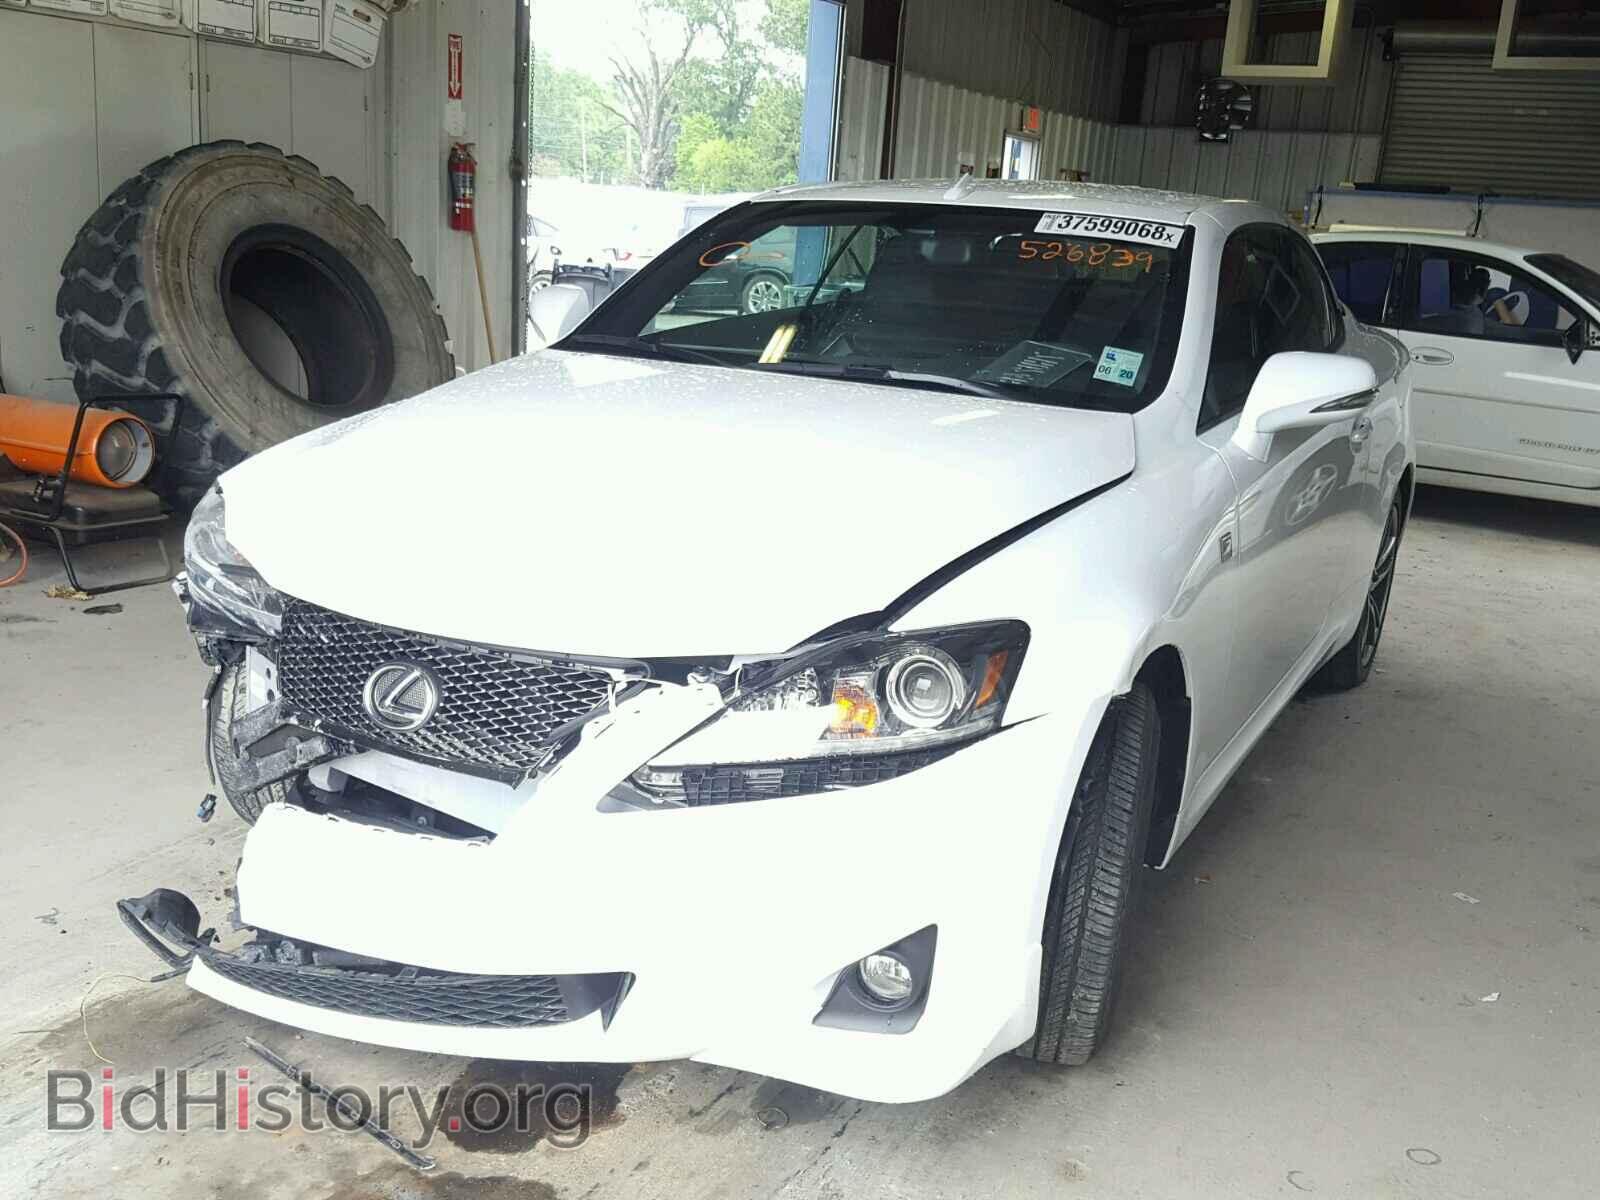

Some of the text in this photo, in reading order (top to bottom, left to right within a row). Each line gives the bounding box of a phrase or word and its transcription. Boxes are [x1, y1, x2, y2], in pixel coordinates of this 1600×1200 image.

[1019, 241, 1152, 273] 526839
[1098, 365, 1134, 379] 06 20
